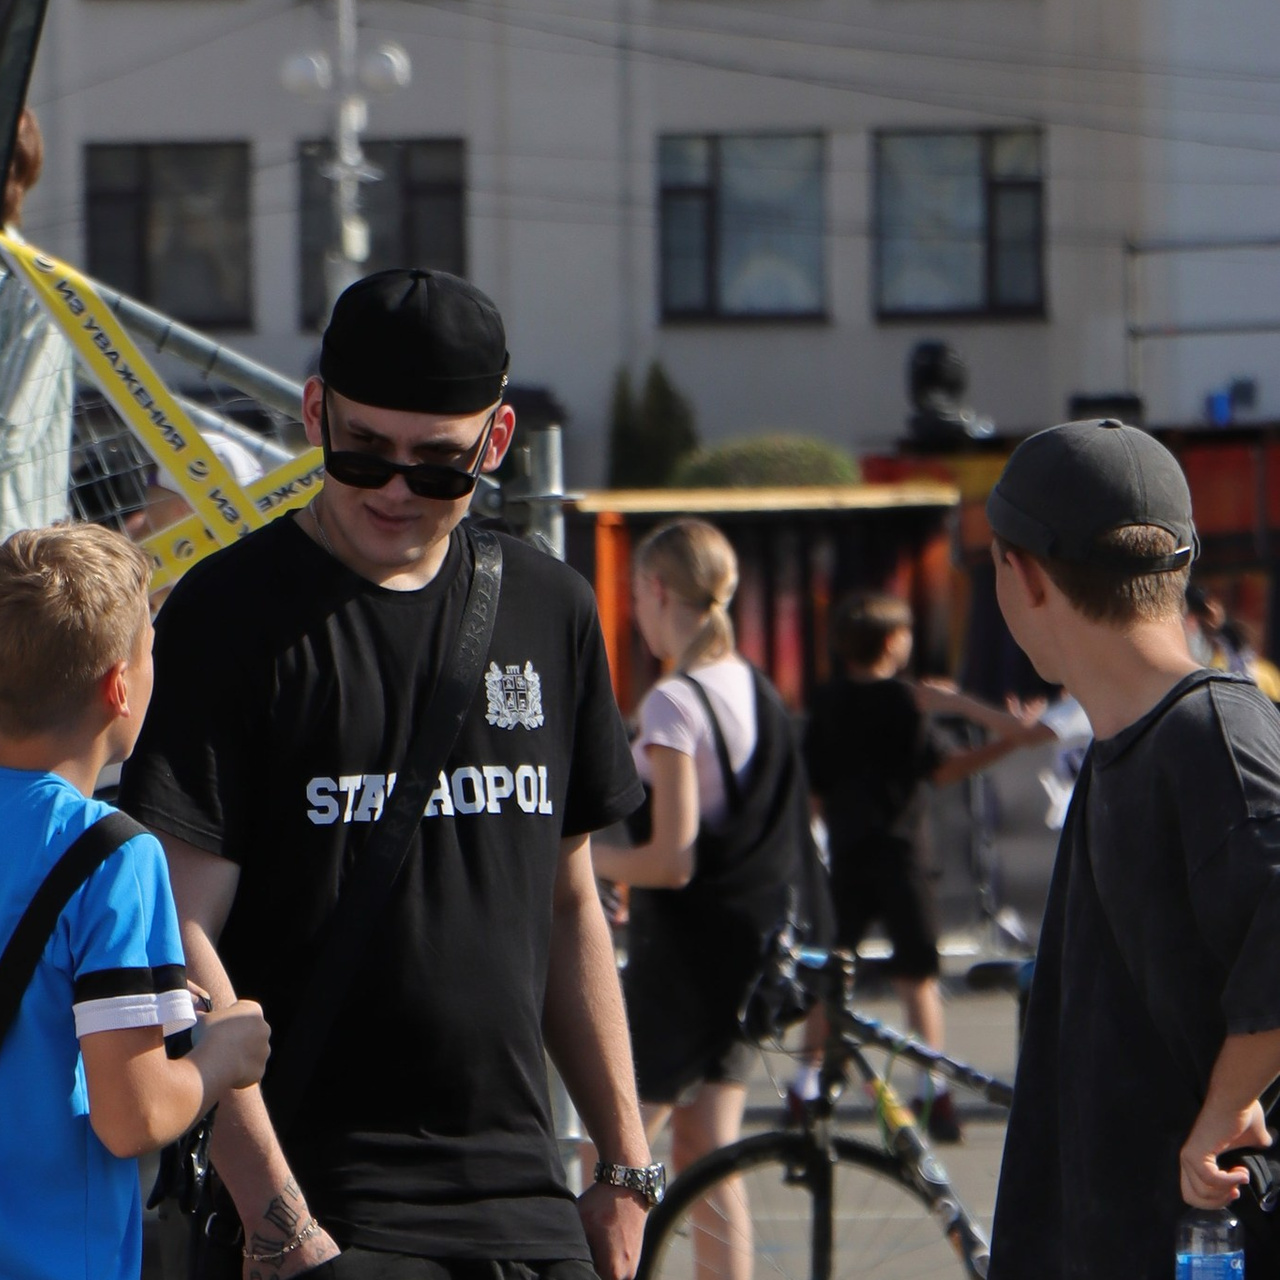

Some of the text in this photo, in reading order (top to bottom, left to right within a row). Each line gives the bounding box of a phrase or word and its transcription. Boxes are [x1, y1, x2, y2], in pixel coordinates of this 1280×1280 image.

[56, 279, 188, 453] ИЗ УВАЖЕНИЯ
[209, 489, 240, 522] ИЗ
